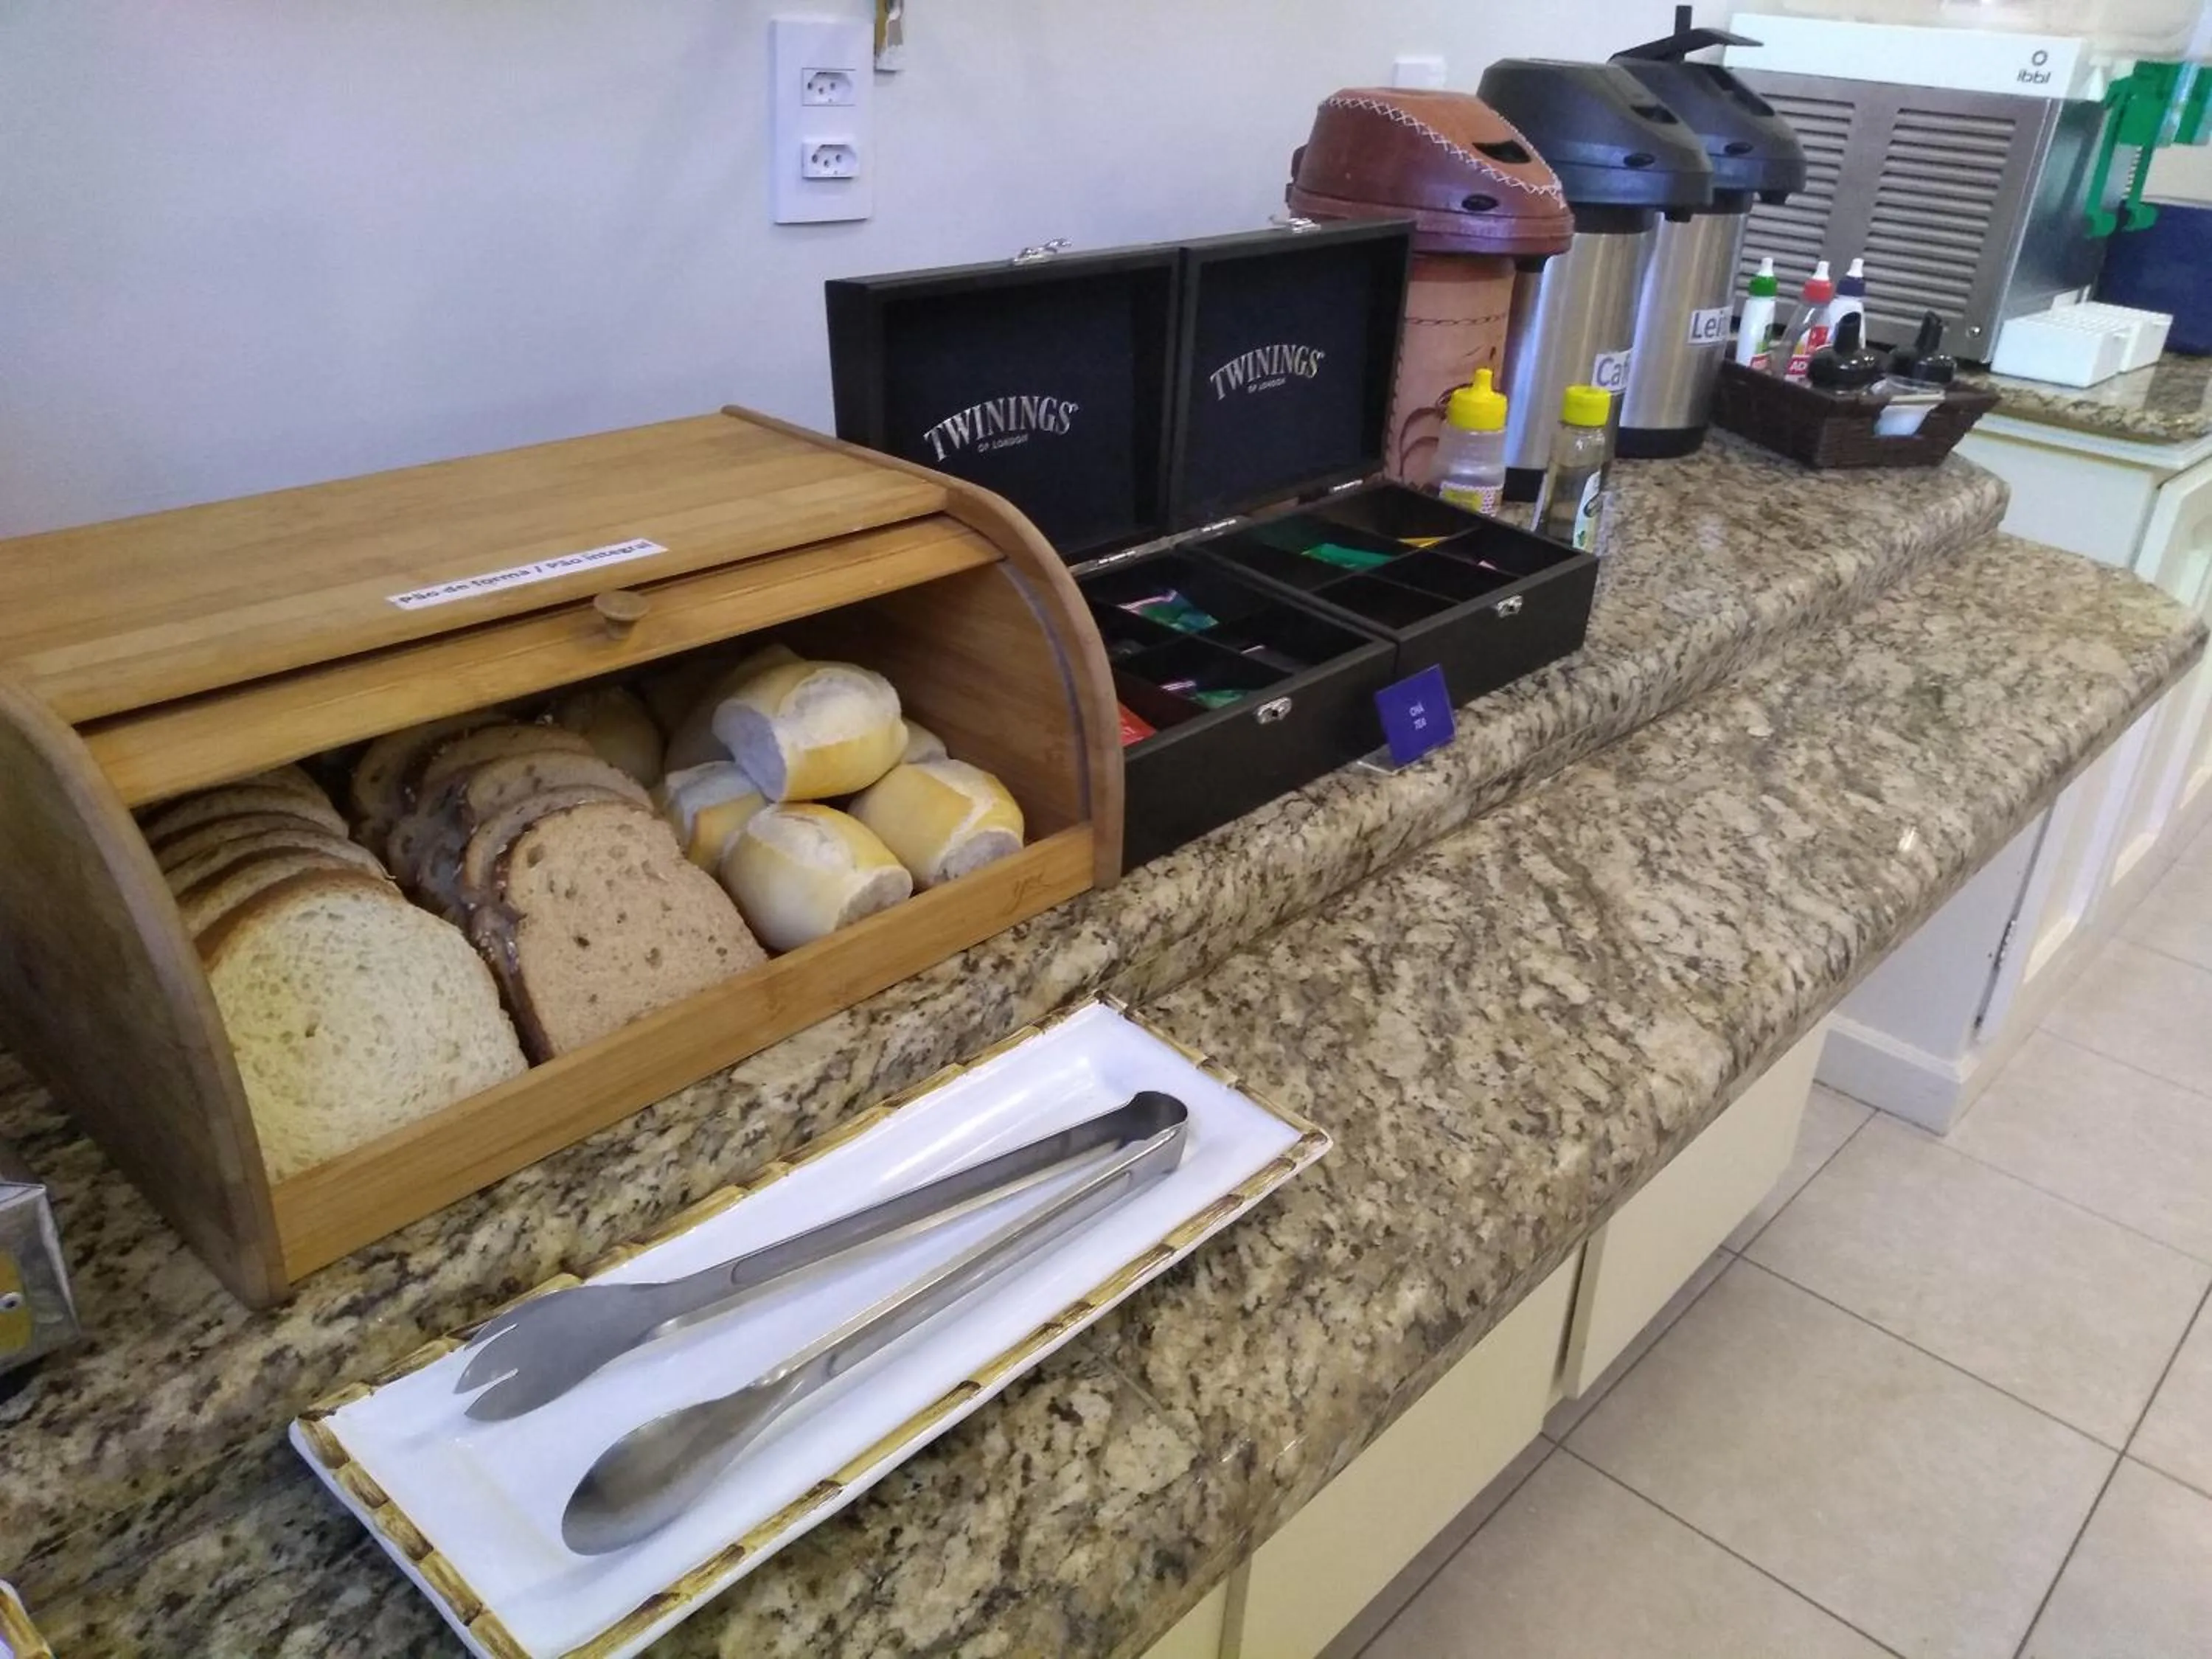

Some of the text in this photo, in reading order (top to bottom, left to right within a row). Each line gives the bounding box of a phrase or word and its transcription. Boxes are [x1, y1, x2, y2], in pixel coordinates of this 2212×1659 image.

[1210, 344, 1321, 400] TWININGS
[1596, 354, 1630, 386] Caf
[922, 395, 1072, 462] TWININGS
[470, 568, 531, 587] forma
